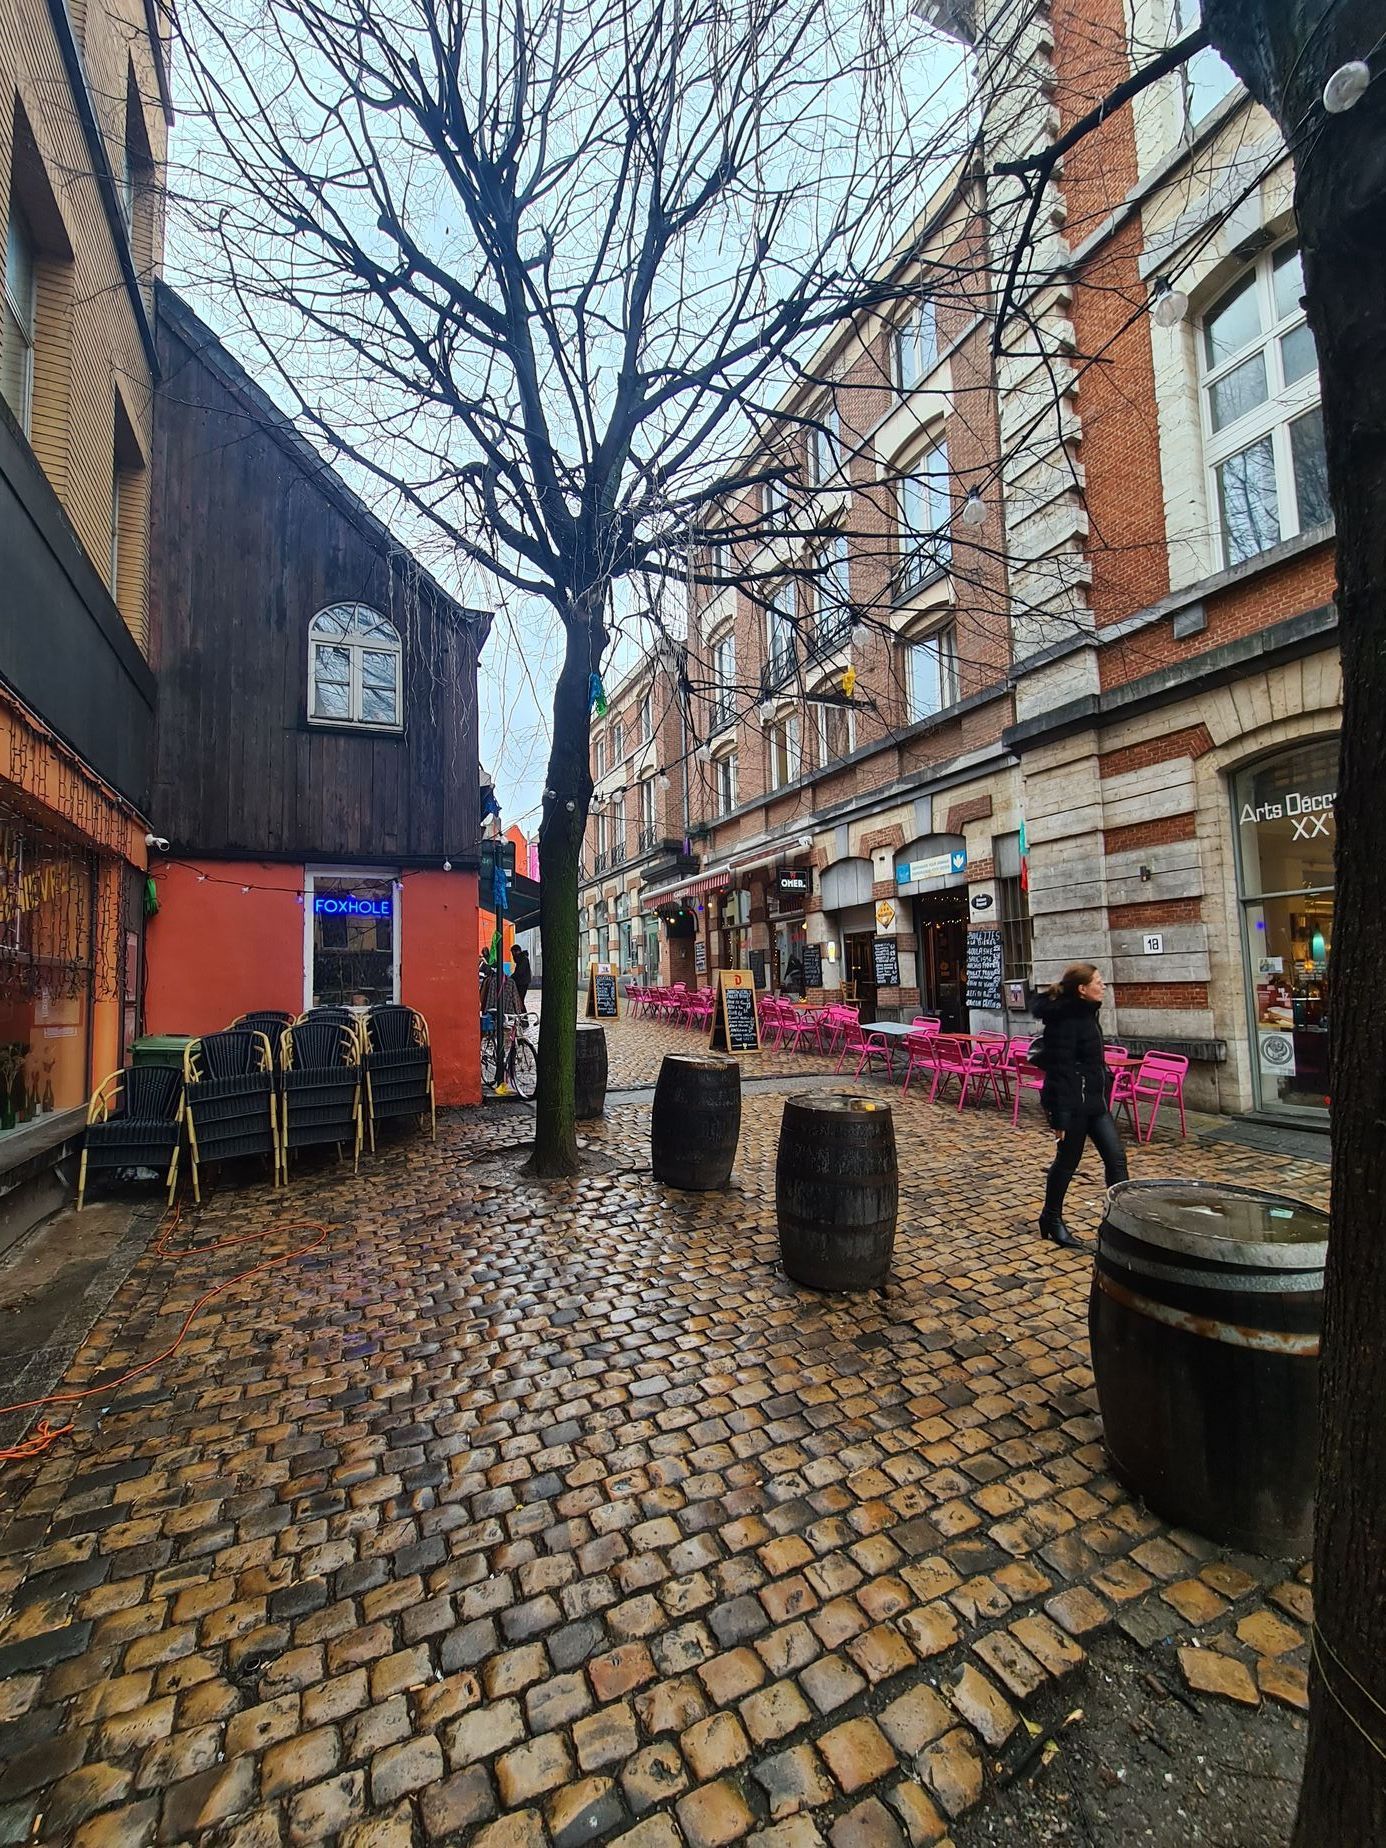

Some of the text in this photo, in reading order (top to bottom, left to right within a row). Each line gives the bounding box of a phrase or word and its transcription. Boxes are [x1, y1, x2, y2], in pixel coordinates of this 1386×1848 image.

[1240, 792, 1337, 825] Arts Déco
[315, 899, 390, 914] FOXHOLE
